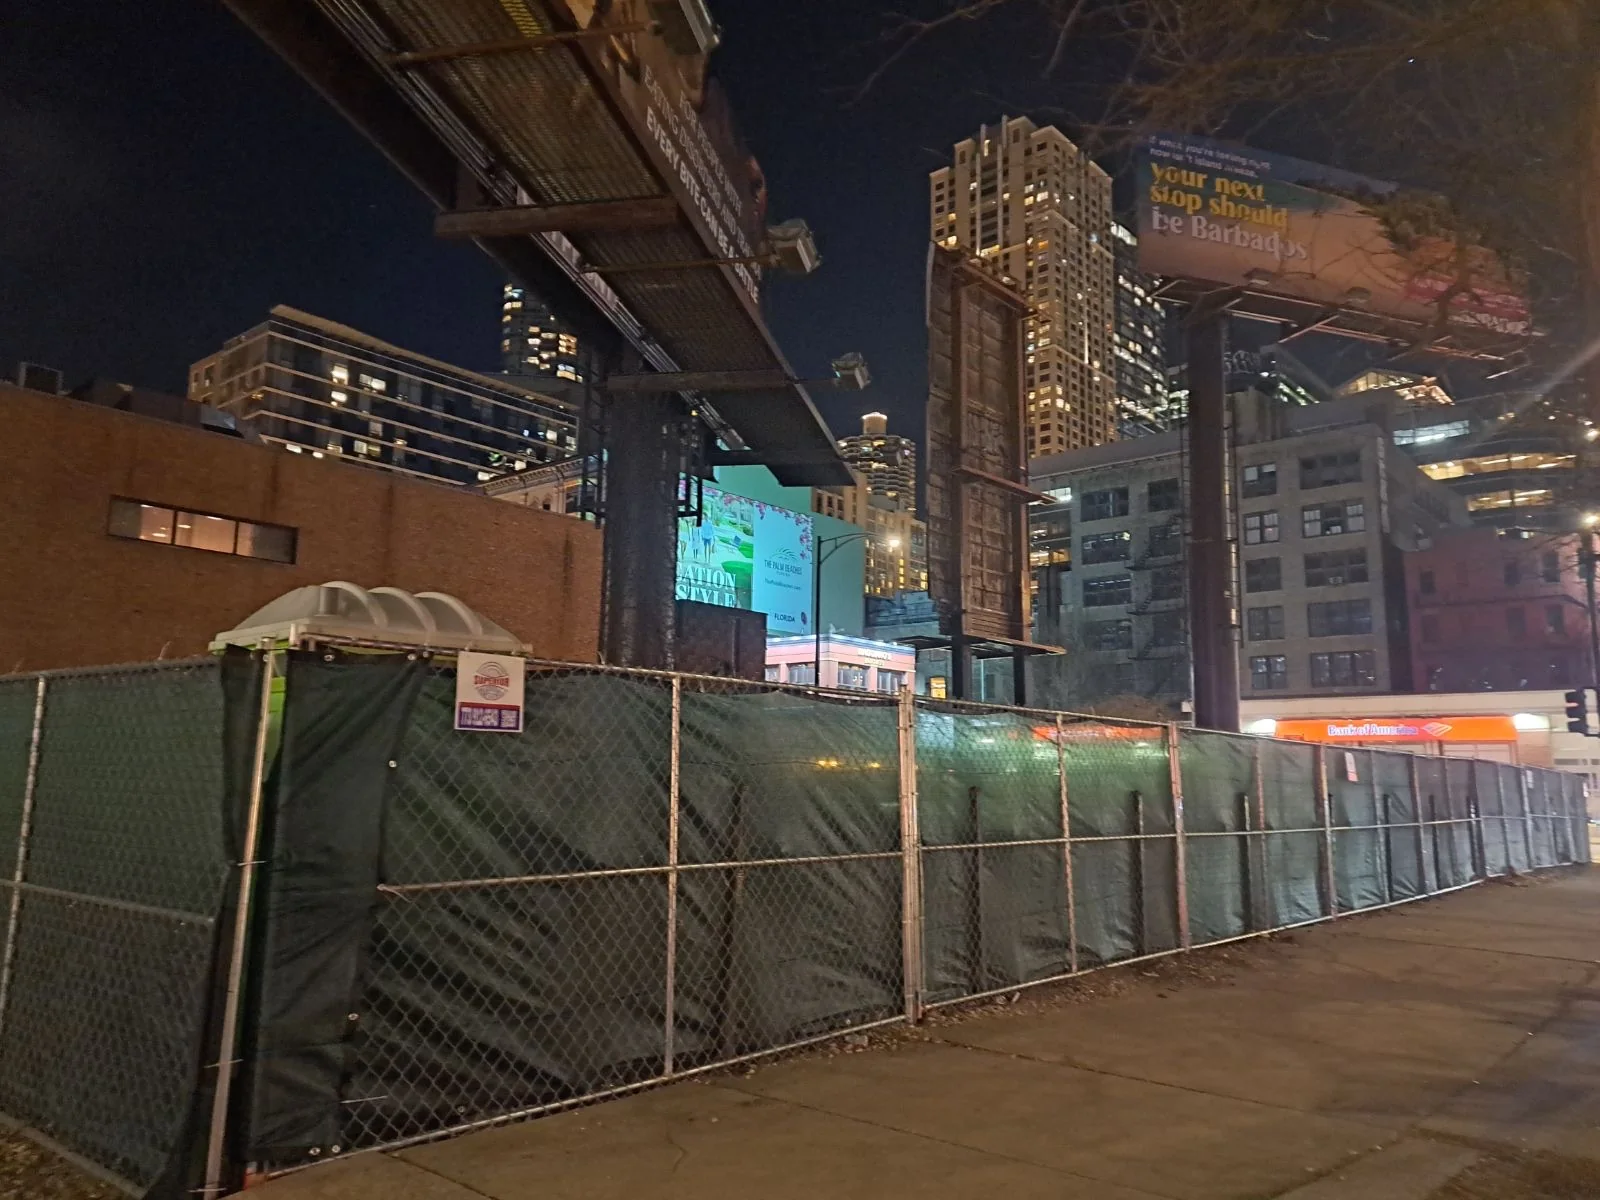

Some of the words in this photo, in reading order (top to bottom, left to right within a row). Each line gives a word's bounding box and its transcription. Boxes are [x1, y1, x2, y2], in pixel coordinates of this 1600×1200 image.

[1150, 147, 1170, 158] now
[646, 105, 680, 170] EVERY
[680, 160, 700, 206] BITE
[700, 196, 718, 238] CAN
[717, 226, 729, 255] BE
[1150, 162, 1208, 189] your
[1215, 176, 1265, 201] next
[1150, 182, 1202, 215] stop
[1209, 195, 1288, 228] should
[1152, 206, 1183, 234] be
[1191, 214, 1307, 260] Barbados
[764, 560, 772, 569] THE
[772, 561, 784, 572] PALM
[675, 584, 736, 608] STYLE
[774, 612, 795, 623] FLORIDA
[1328, 725, 1356, 736] Bank
[1356, 724, 1370, 736] of
